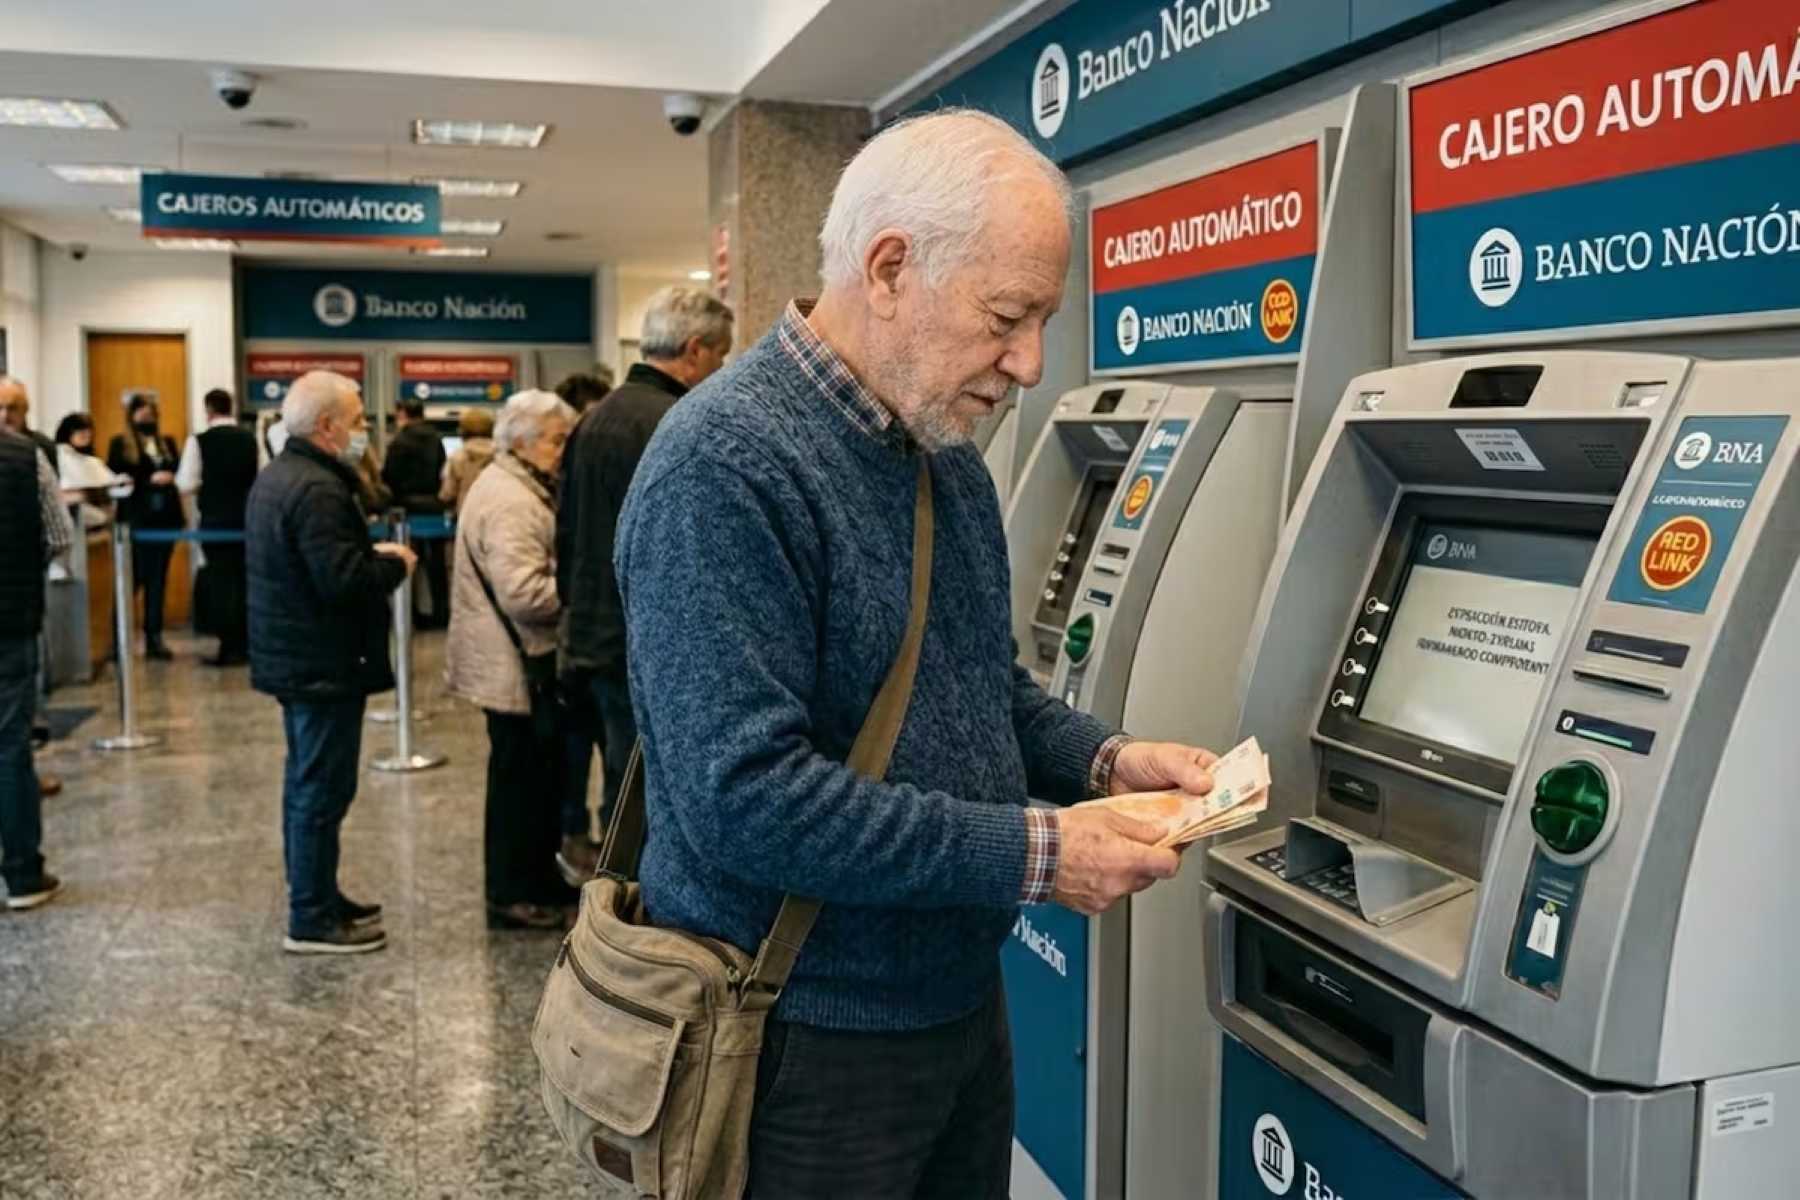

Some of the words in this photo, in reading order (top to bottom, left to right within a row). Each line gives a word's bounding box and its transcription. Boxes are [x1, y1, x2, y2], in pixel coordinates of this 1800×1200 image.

[1078, 30, 1153, 100] Banco
[1439, 94, 1585, 170] CAJERO
[157, 192, 257, 216] CAJEROS
[263, 196, 426, 223] AUTOMÁTICOS
[1167, 190, 1302, 255] AUTOMÁTICO
[1535, 231, 1652, 282] BANCO
[365, 294, 438, 318] Banco
[444, 294, 527, 319] Nación
[1143, 312, 1190, 342] BANCO
[1192, 300, 1253, 336] NACIÓN
[1712, 441, 1763, 464] BNA
[1448, 541, 1476, 560] BNA
[1647, 550, 1699, 573] LINK
[1303, 1160, 1343, 1200] Ba
